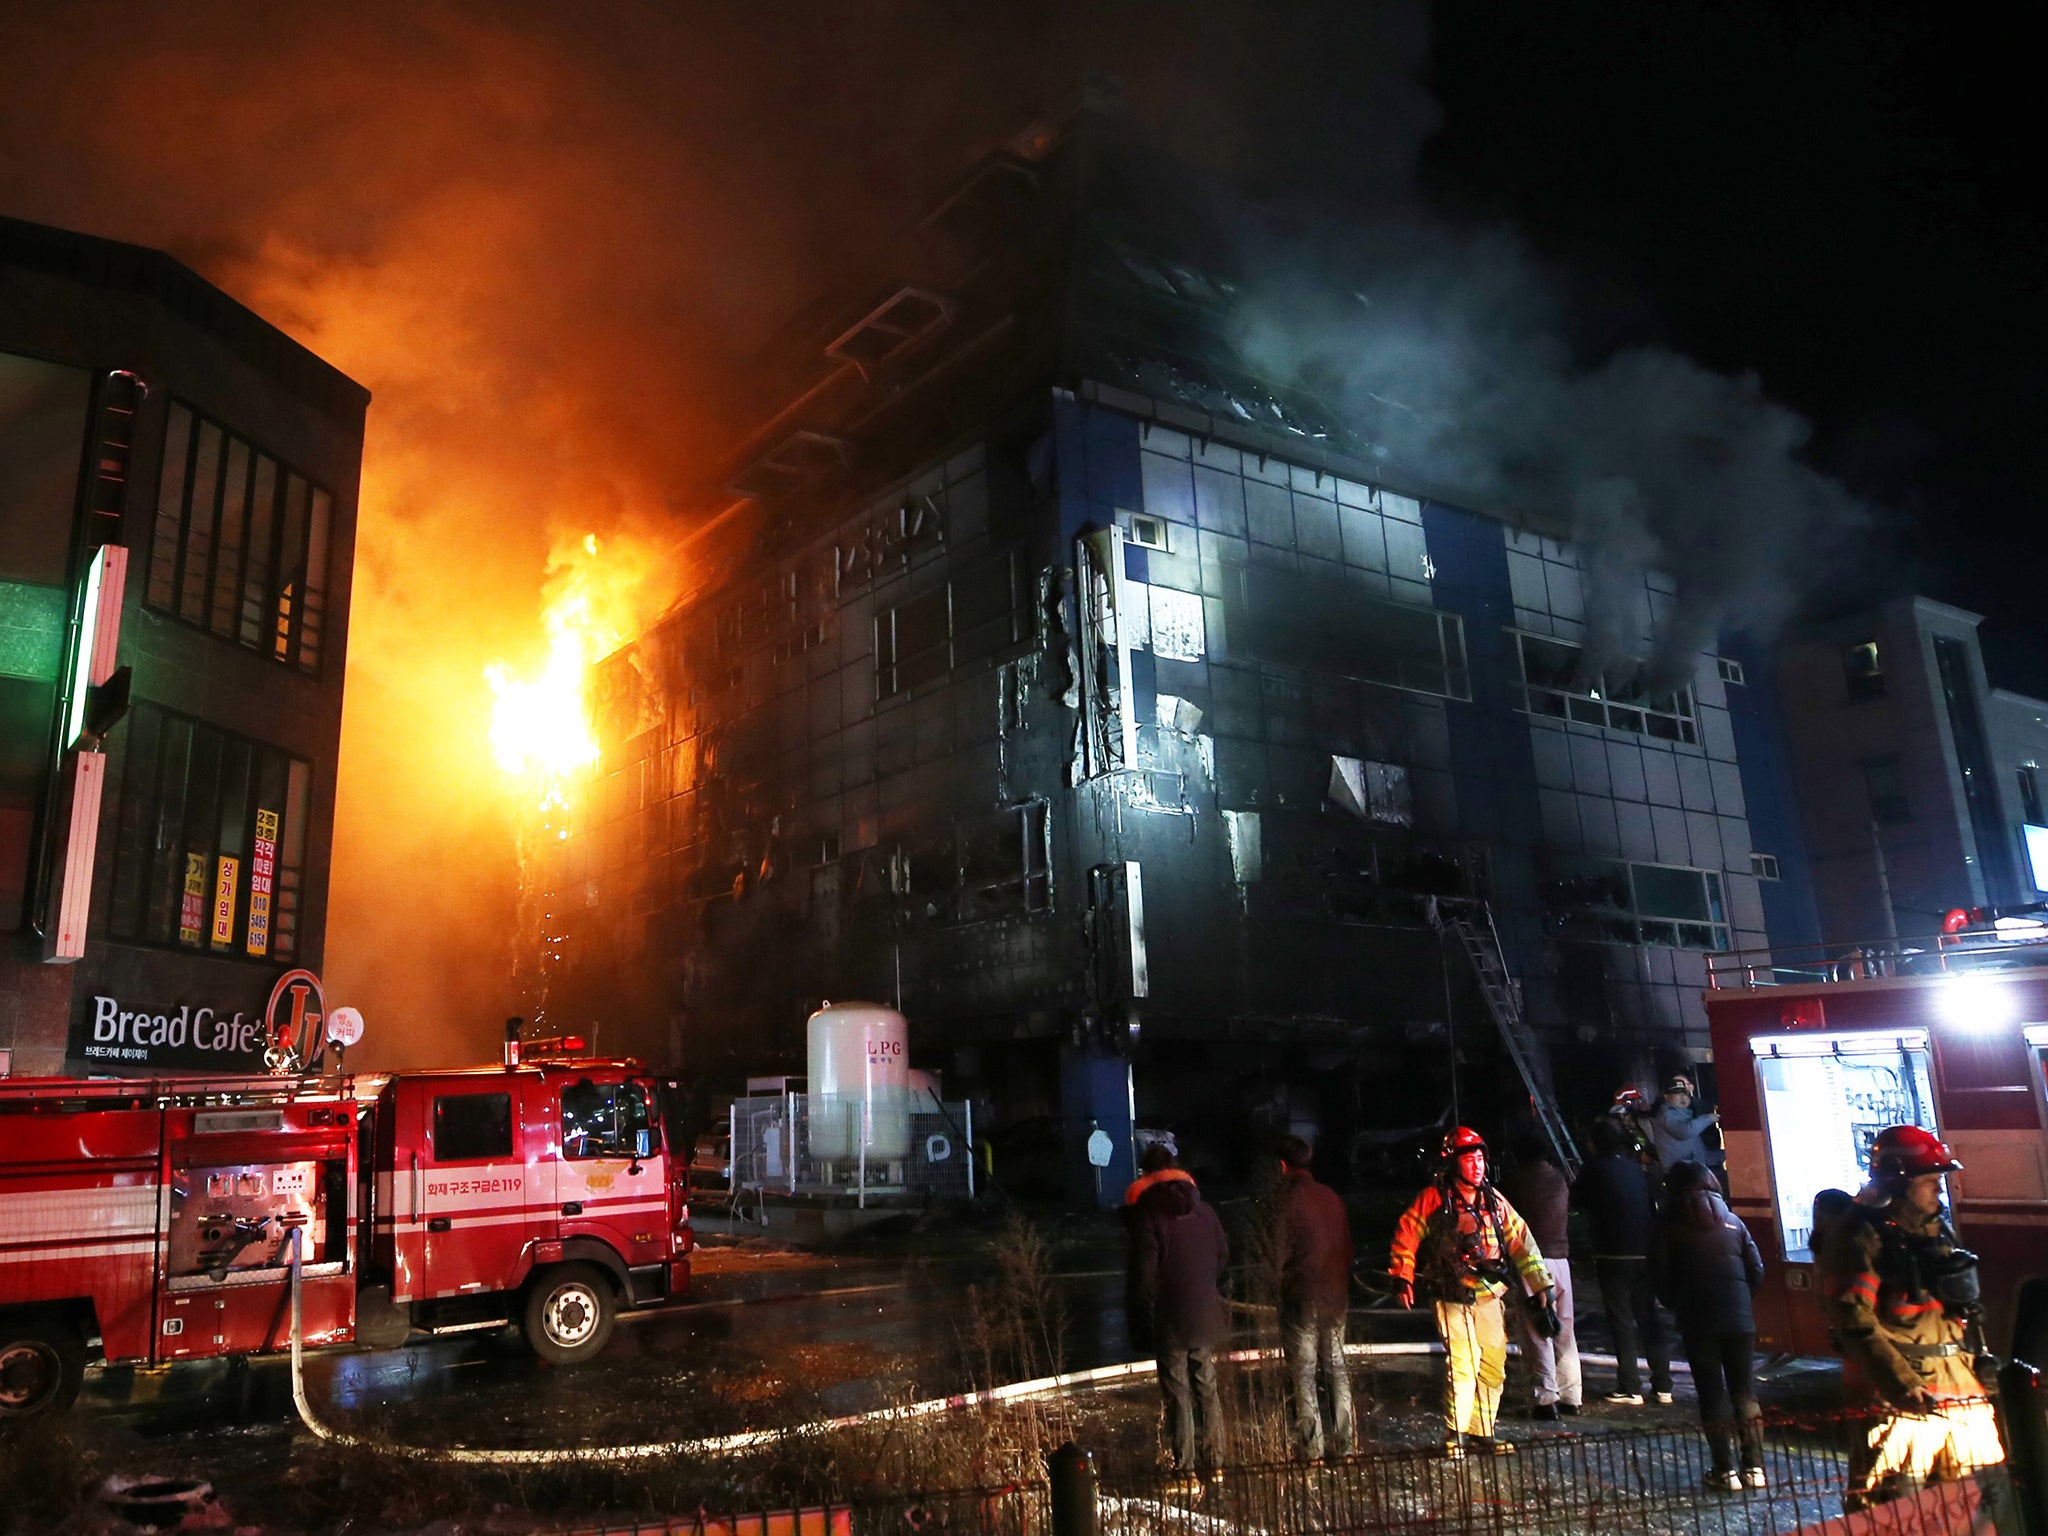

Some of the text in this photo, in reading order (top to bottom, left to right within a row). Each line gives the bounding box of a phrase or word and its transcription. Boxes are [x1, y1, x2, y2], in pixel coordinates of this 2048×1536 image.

[255, 840, 275, 859] 각각
[251, 875, 272, 894] 임대
[254, 896, 267, 911] 010
[93, 996, 188, 1047] Bread
[336, 1028, 355, 1038] 커피
[84, 1045, 148, 1060] 브레드카페 제이제이
[867, 1041, 901, 1056] LPG
